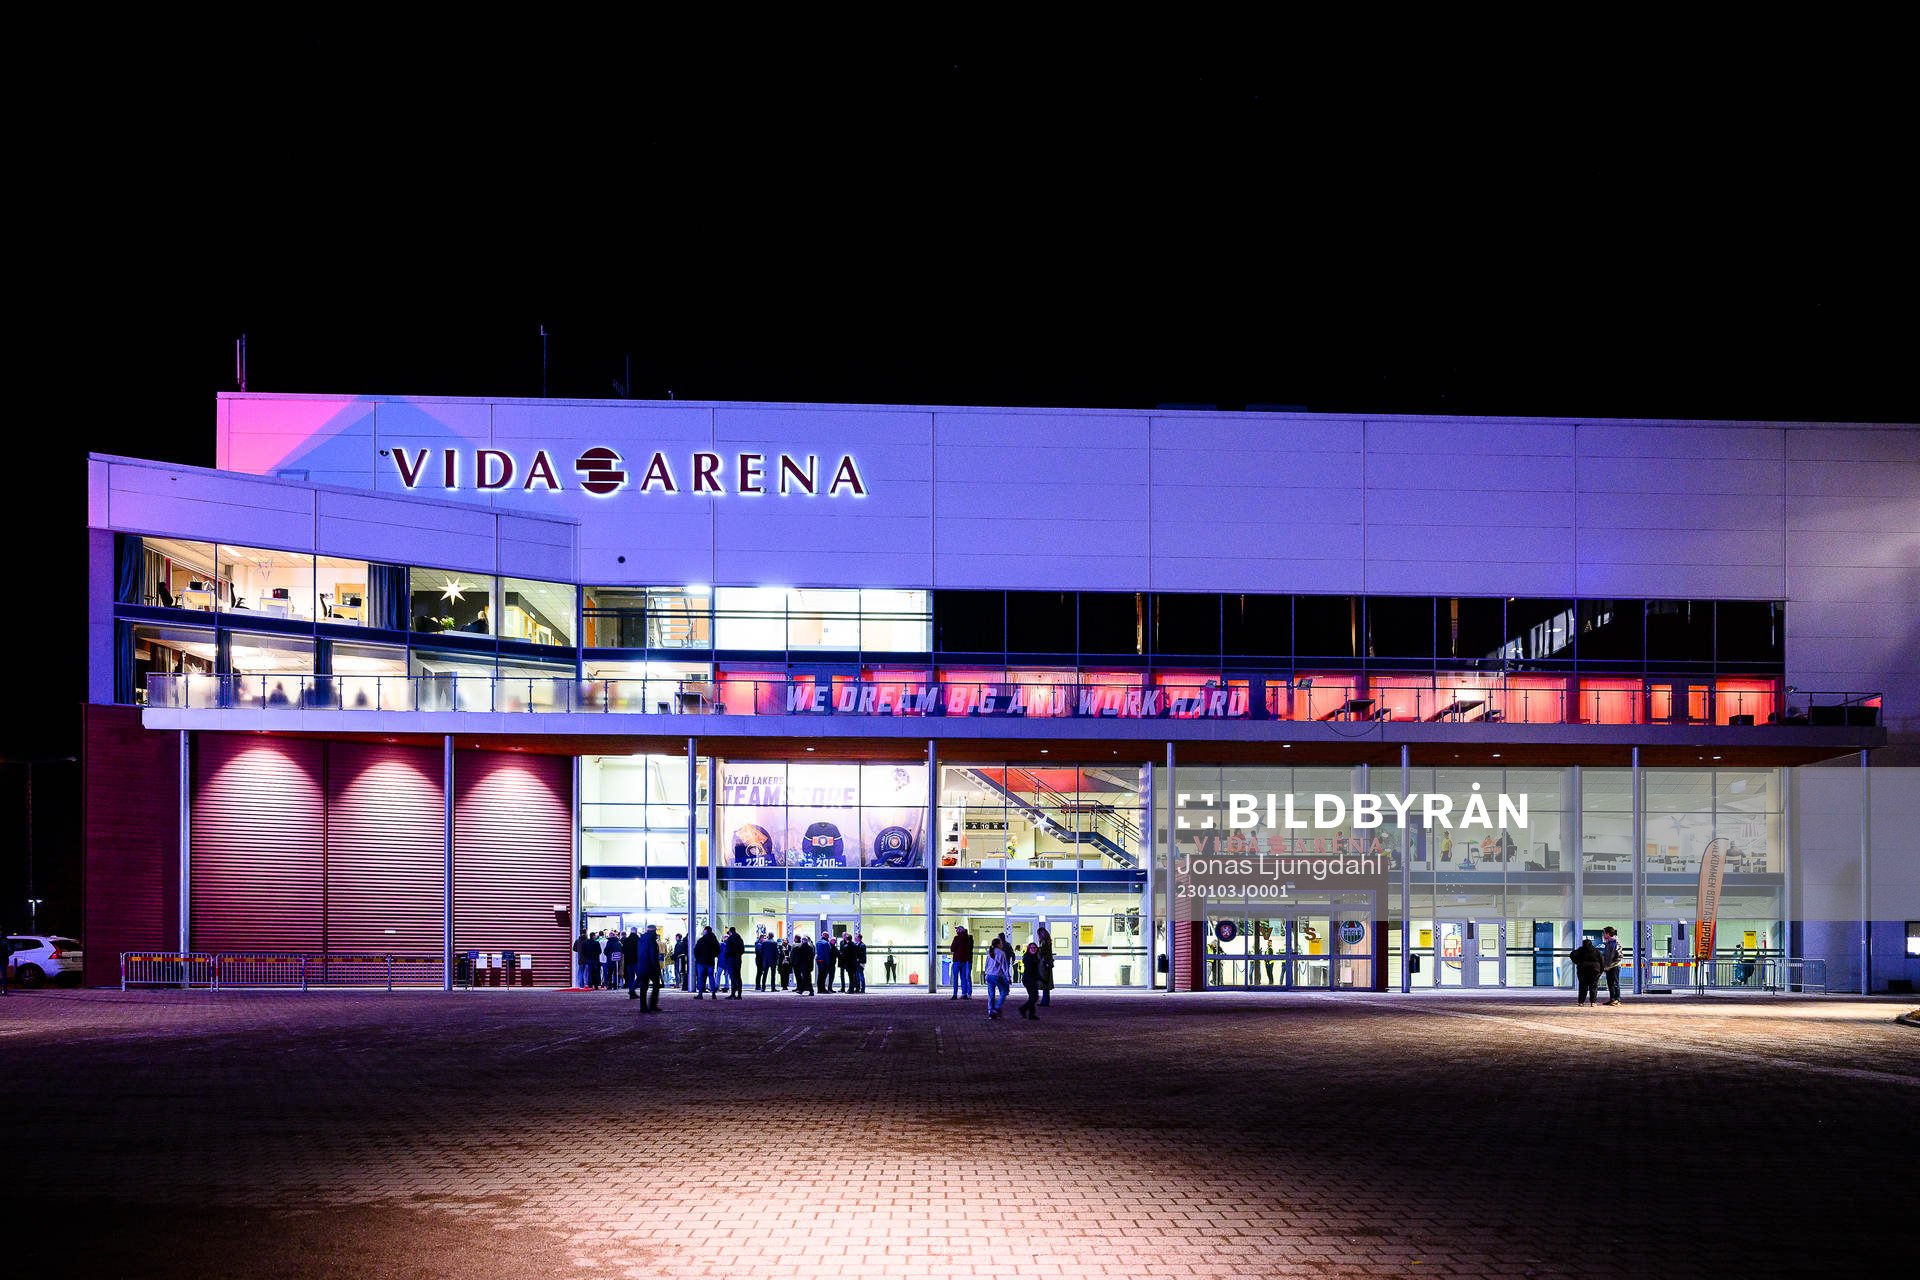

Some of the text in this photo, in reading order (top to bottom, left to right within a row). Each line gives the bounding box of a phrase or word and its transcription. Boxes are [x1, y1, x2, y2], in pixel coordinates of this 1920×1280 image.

[392, 448, 870, 496] VIDA ARENA
[787, 685, 1249, 716] WE DREAM BIG AND WORK HARD
[752, 776, 785, 785] LAKERS
[1193, 836, 1384, 854] VIDA ARENA
